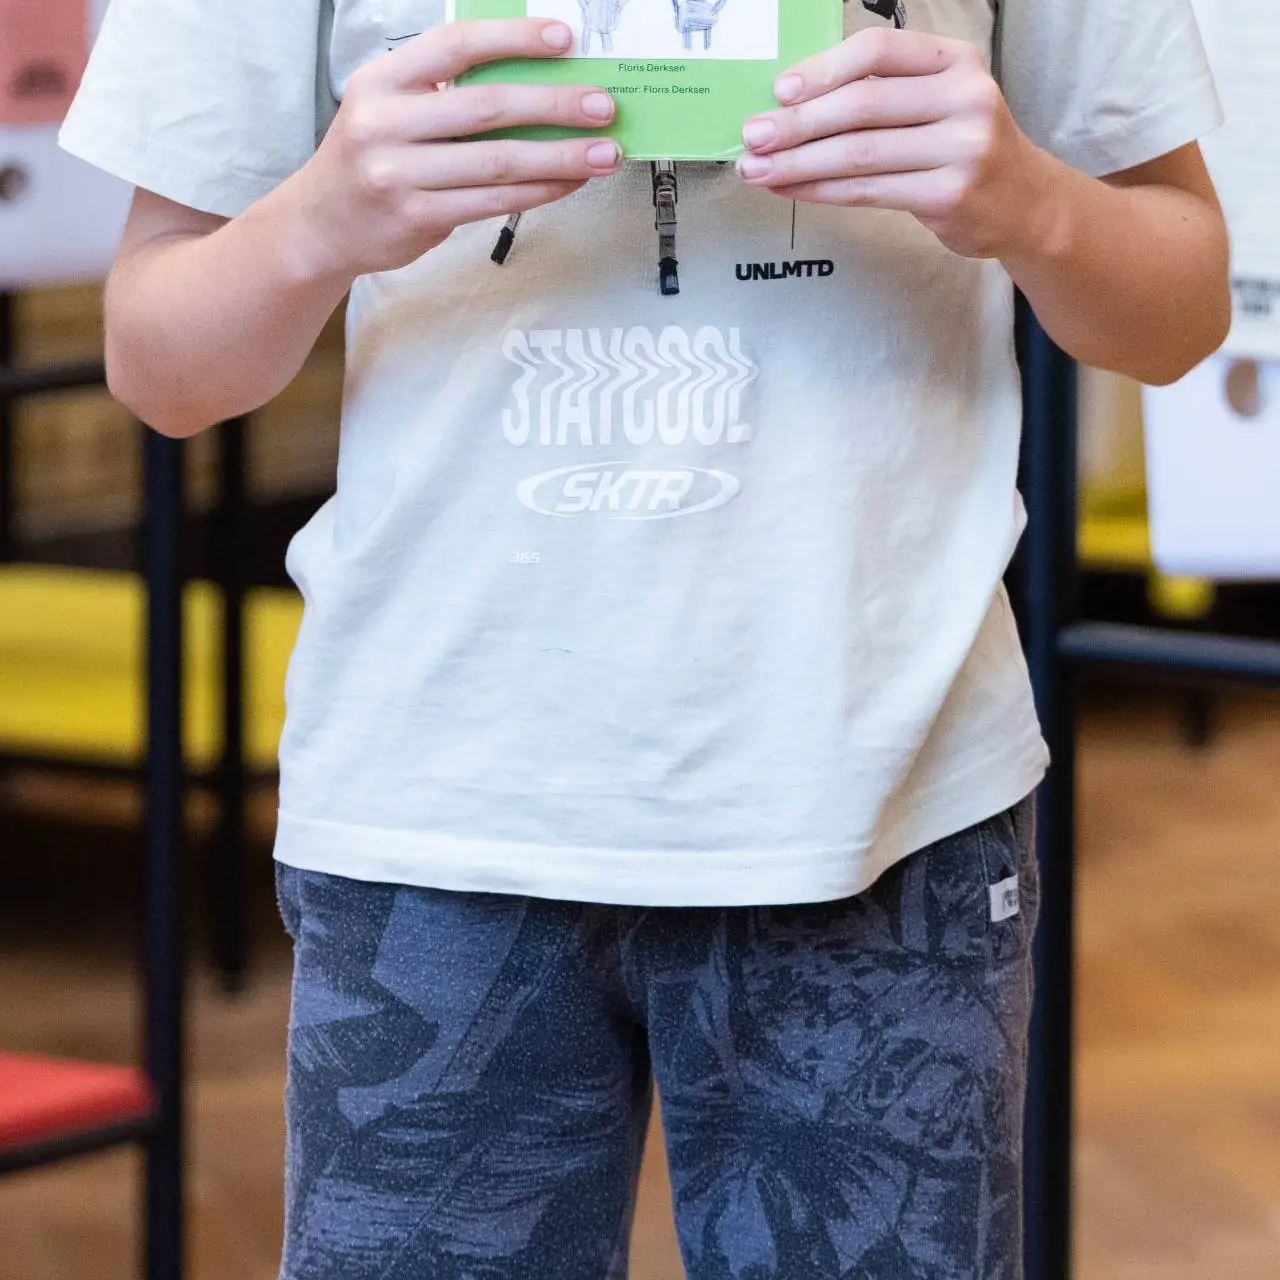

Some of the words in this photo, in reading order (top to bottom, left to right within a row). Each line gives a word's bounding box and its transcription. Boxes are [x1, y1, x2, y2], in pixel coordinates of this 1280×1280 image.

[618, 63, 645, 72] Floris
[646, 63, 686, 72] Derksen
[643, 85, 670, 94] Floris
[671, 85, 711, 94] Derksen
[735, 259, 835, 282] UNLMTD
[559, 470, 695, 512] SKTR
